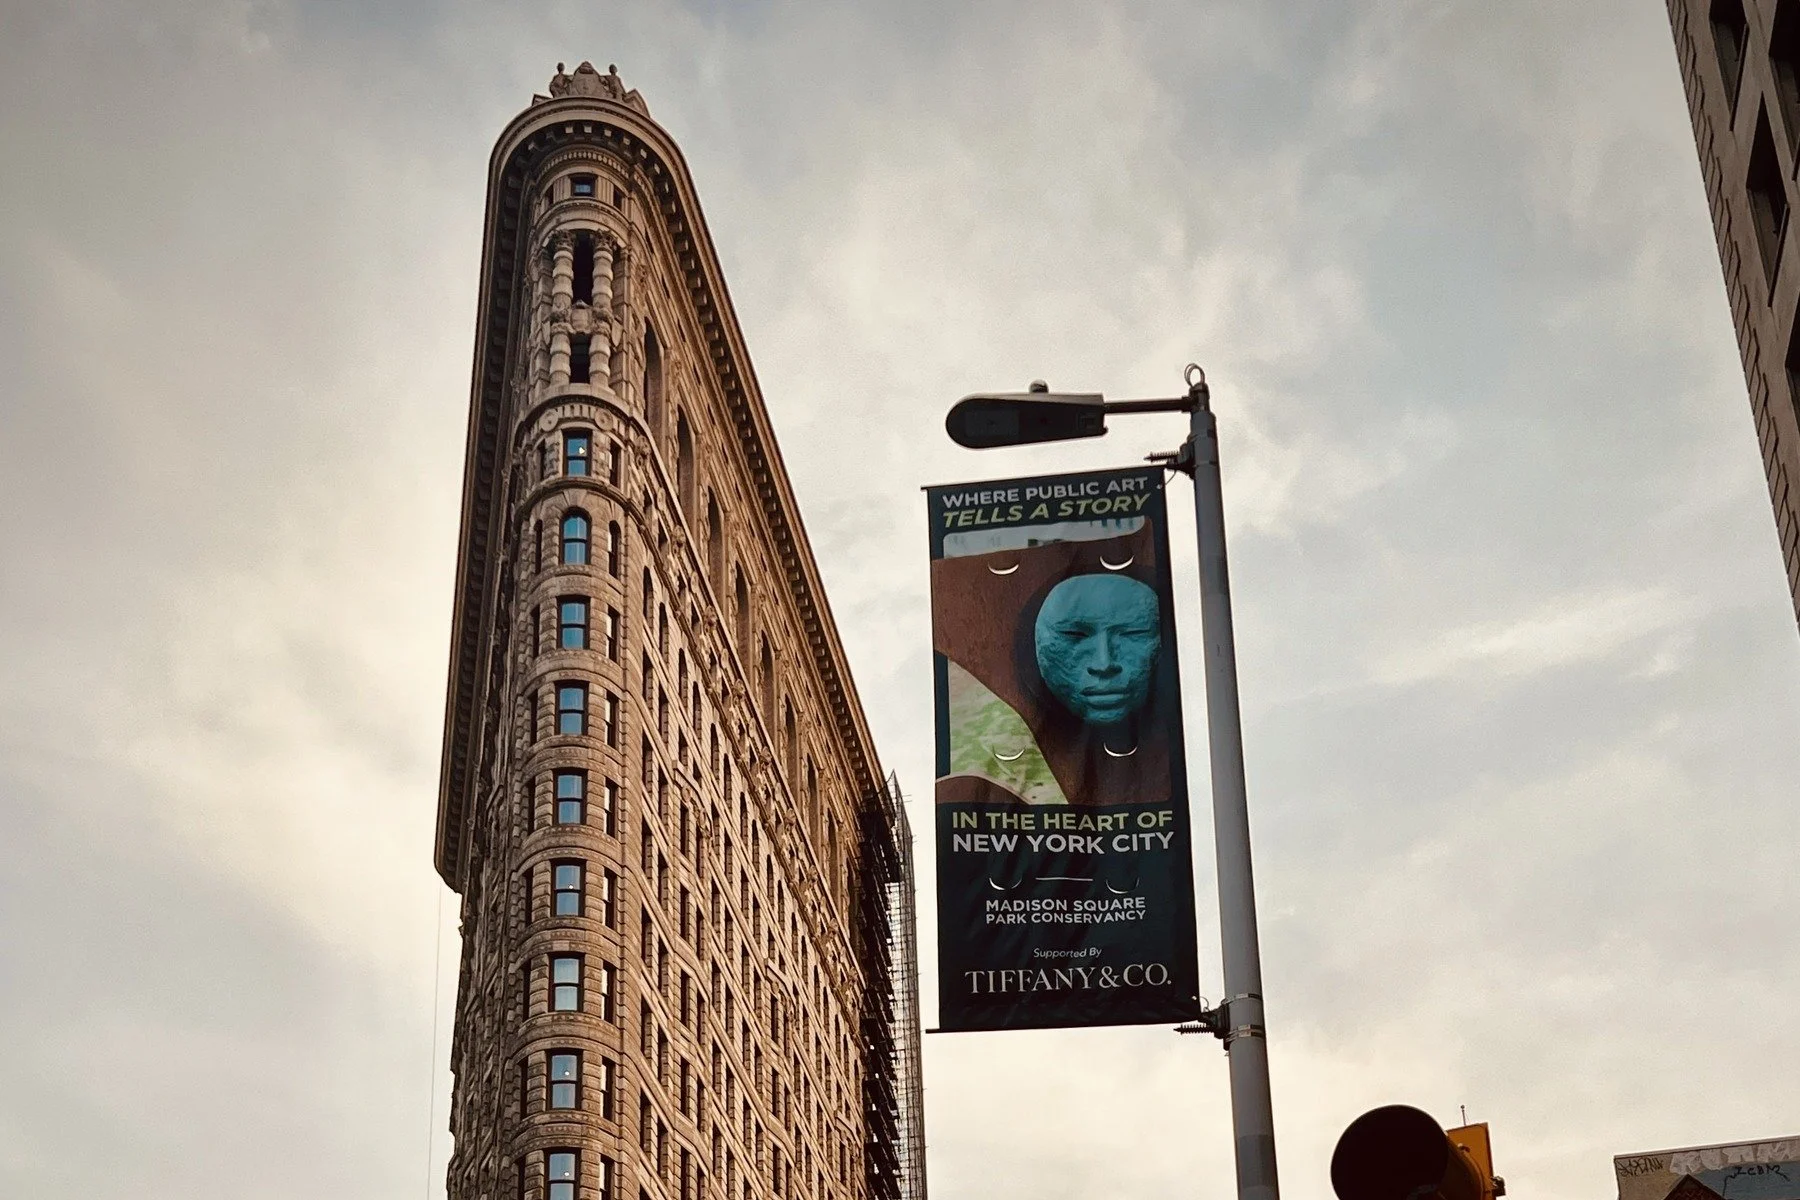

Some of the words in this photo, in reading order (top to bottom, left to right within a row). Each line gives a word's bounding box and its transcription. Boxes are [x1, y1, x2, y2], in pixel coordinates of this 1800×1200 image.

[942, 488, 1019, 508] WHERE
[1025, 482, 1099, 501] PUBLIC
[1106, 476, 1149, 493] ART
[943, 502, 1023, 528] TELLS
[1029, 503, 1050, 520] A
[1057, 493, 1152, 517] STORY
[952, 811, 977, 829] IN
[985, 812, 1035, 831] THE
[1044, 811, 1129, 832] HEART
[1137, 810, 1173, 829] OF
[953, 833, 1018, 853] NEW
[1026, 834, 1105, 854] YORK
[1112, 831, 1174, 852] CITY
[986, 899, 1068, 912] MADISON
[1073, 896, 1146, 912] SQUARE
[986, 911, 1027, 924] PARK
[1031, 910, 1146, 924] CONSERVANCY
[1033, 948, 1087, 960] Supported
[1089, 947, 1102, 959] By
